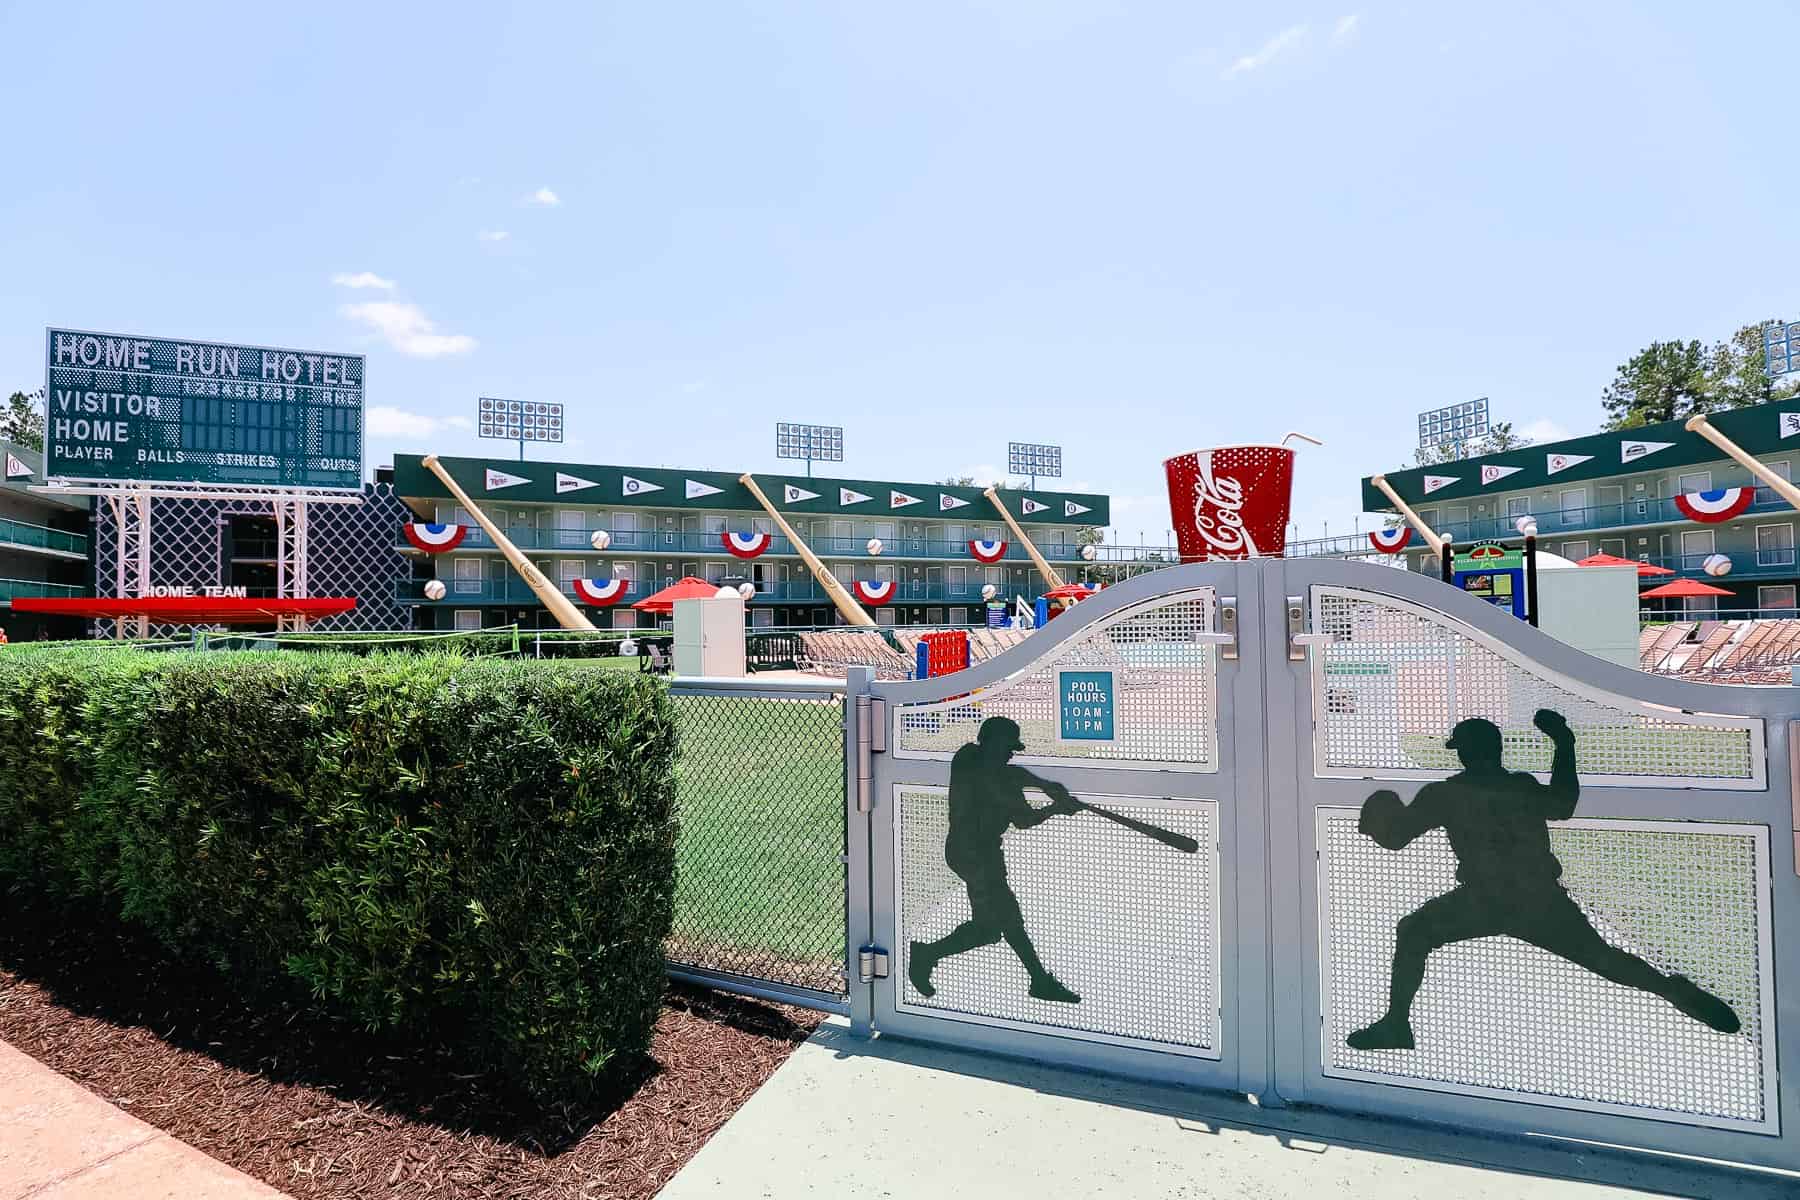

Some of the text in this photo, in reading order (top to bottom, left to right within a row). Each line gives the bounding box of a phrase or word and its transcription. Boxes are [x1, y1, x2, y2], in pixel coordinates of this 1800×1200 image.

[56, 335, 357, 385] HOME RUN HOTEL
[57, 390, 161, 416] VISITOR
[56, 419, 129, 442] HOME
[55, 446, 356, 471] PLAYER BALLS STRIKES OUTS
[145, 586, 247, 598] HOME TEAM
[1071, 681, 1102, 692] POOL
[1067, 692, 1107, 703] HOURS
[1065, 720, 1103, 732] 11PM
